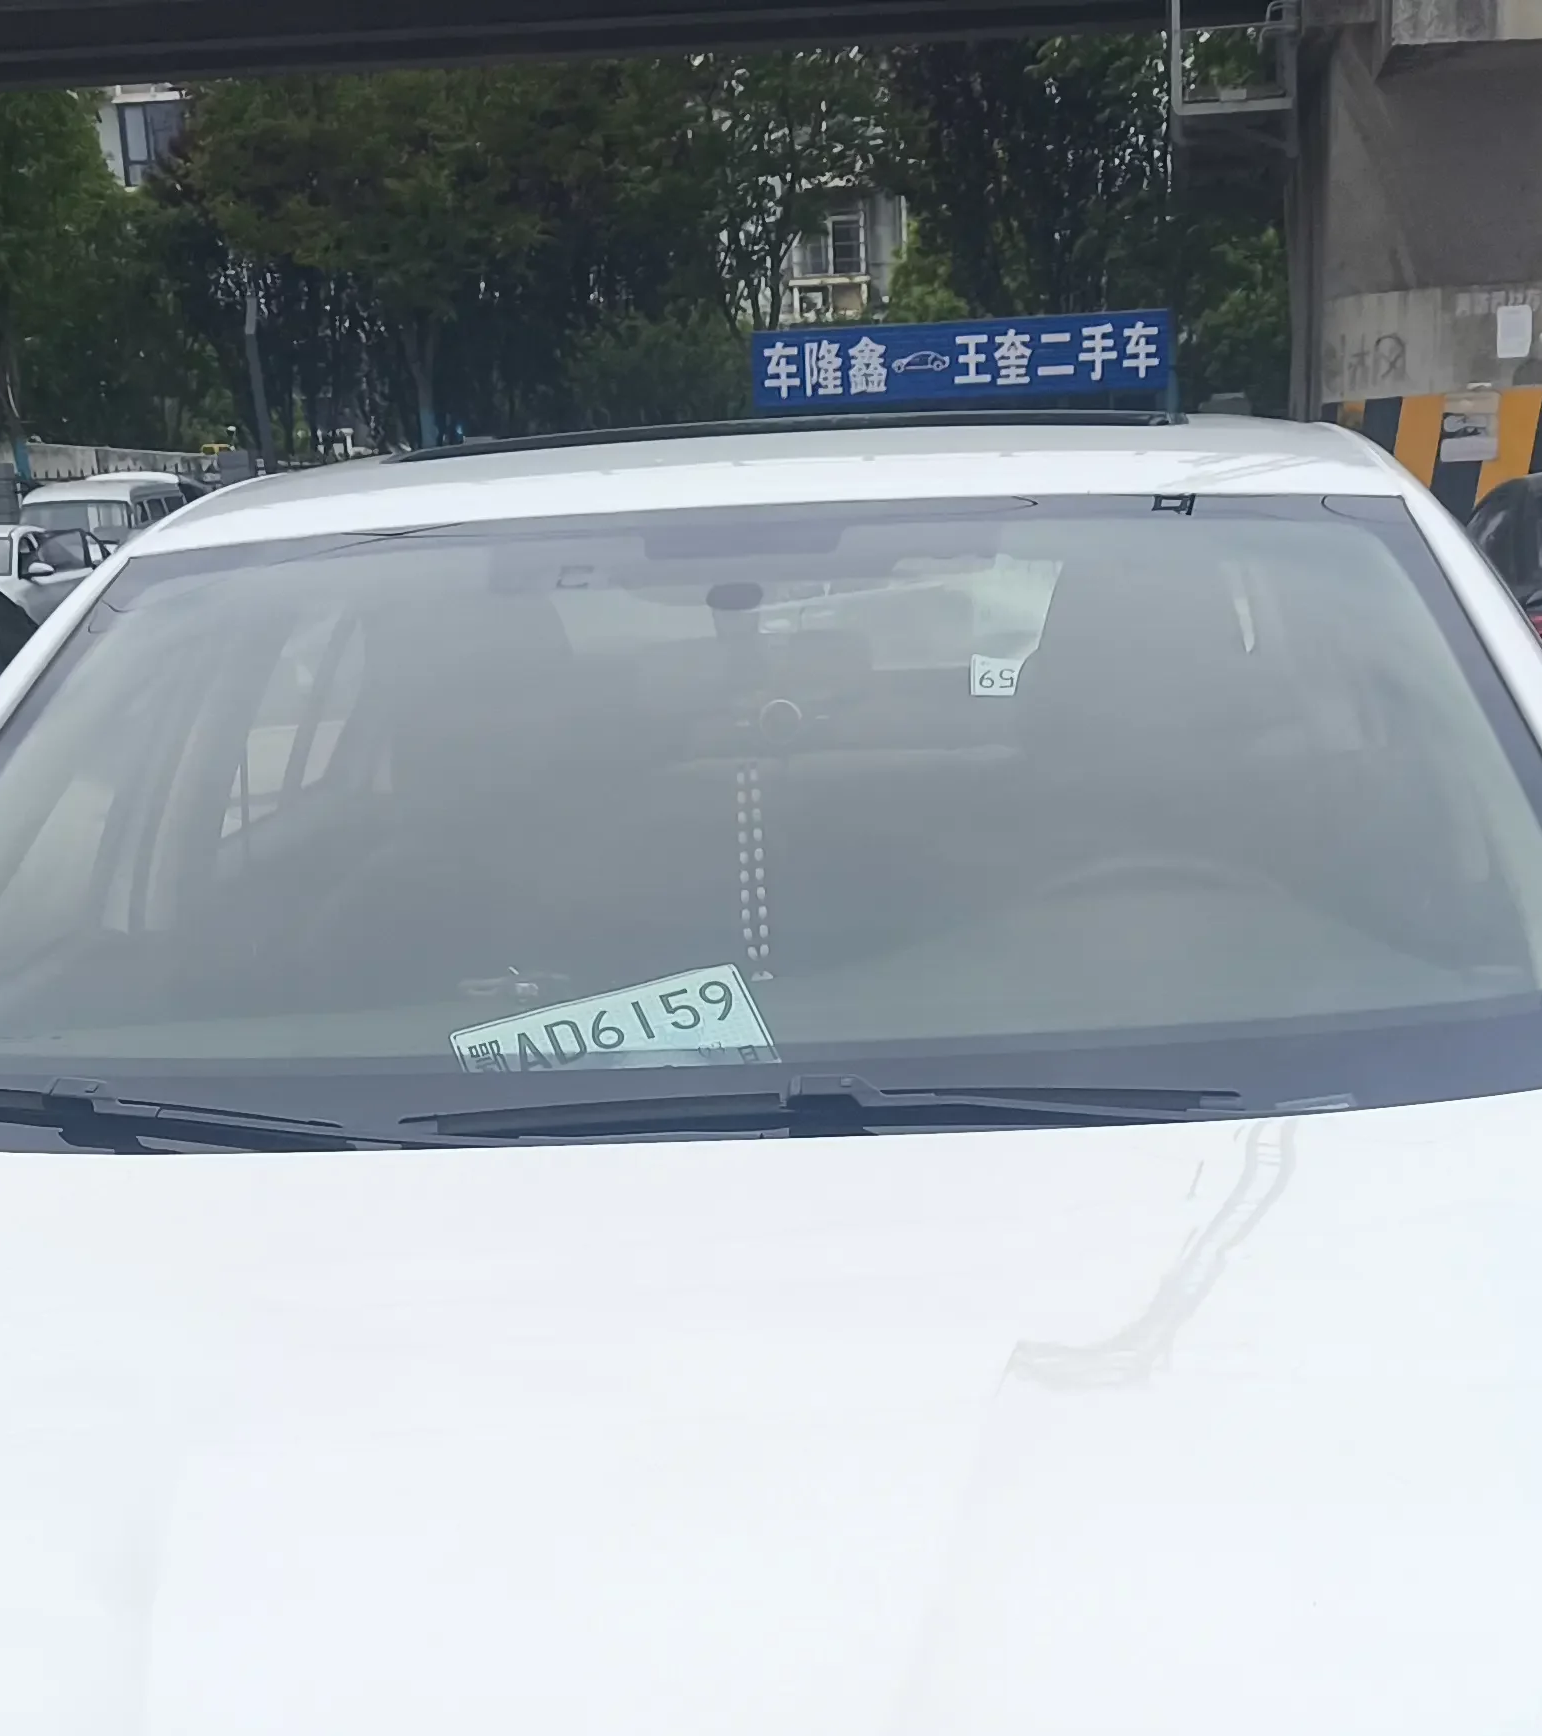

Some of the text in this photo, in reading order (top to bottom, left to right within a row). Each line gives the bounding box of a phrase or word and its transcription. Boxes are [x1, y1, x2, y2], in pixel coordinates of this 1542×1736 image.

[763, 321, 1160, 400] 车隆鑫 王奎二手车
